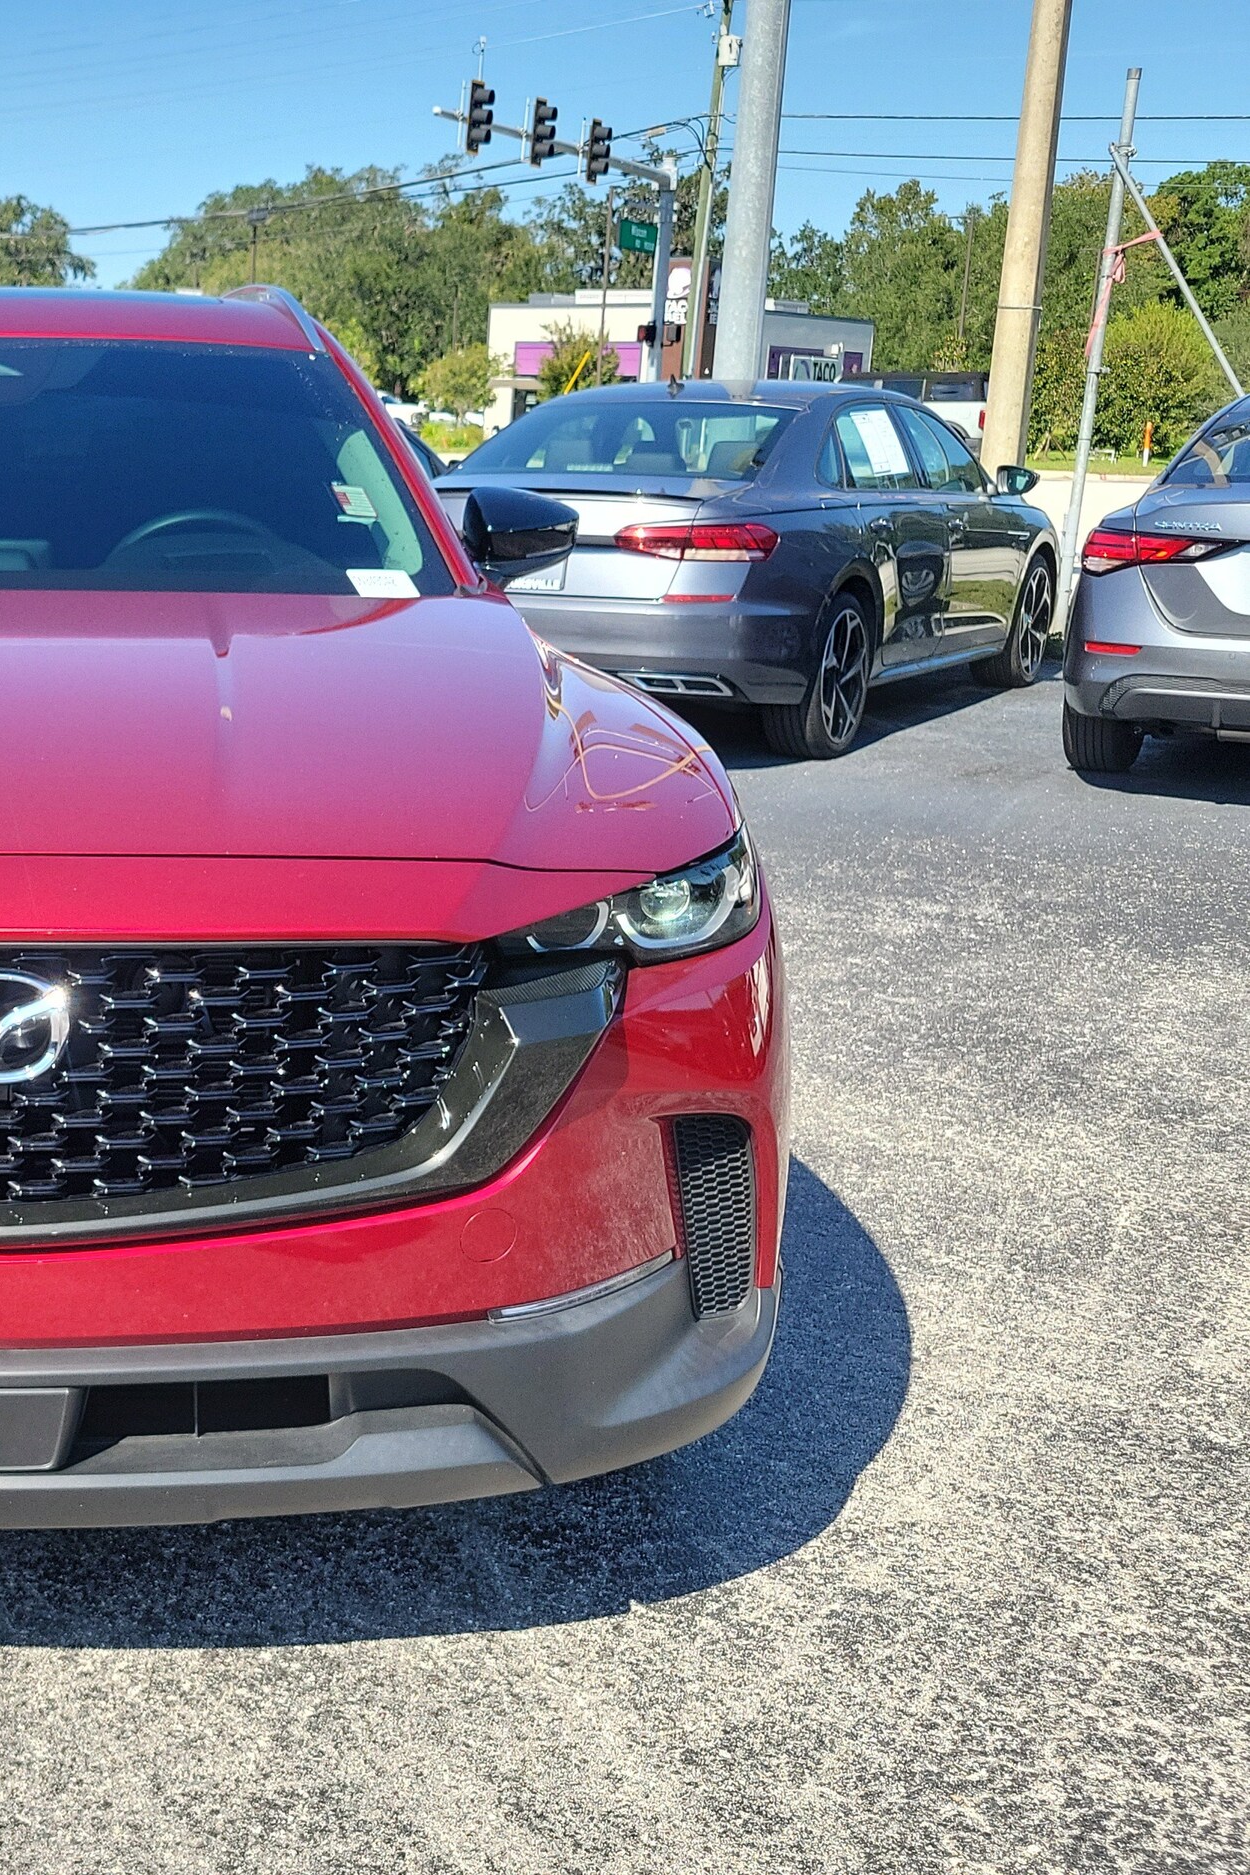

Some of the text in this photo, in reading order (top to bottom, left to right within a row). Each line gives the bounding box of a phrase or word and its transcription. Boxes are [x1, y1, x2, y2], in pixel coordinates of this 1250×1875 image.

[665, 300, 688, 312] TAC
[813, 362, 836, 382] TACO
[1154, 520, 1222, 532] SENTRA
